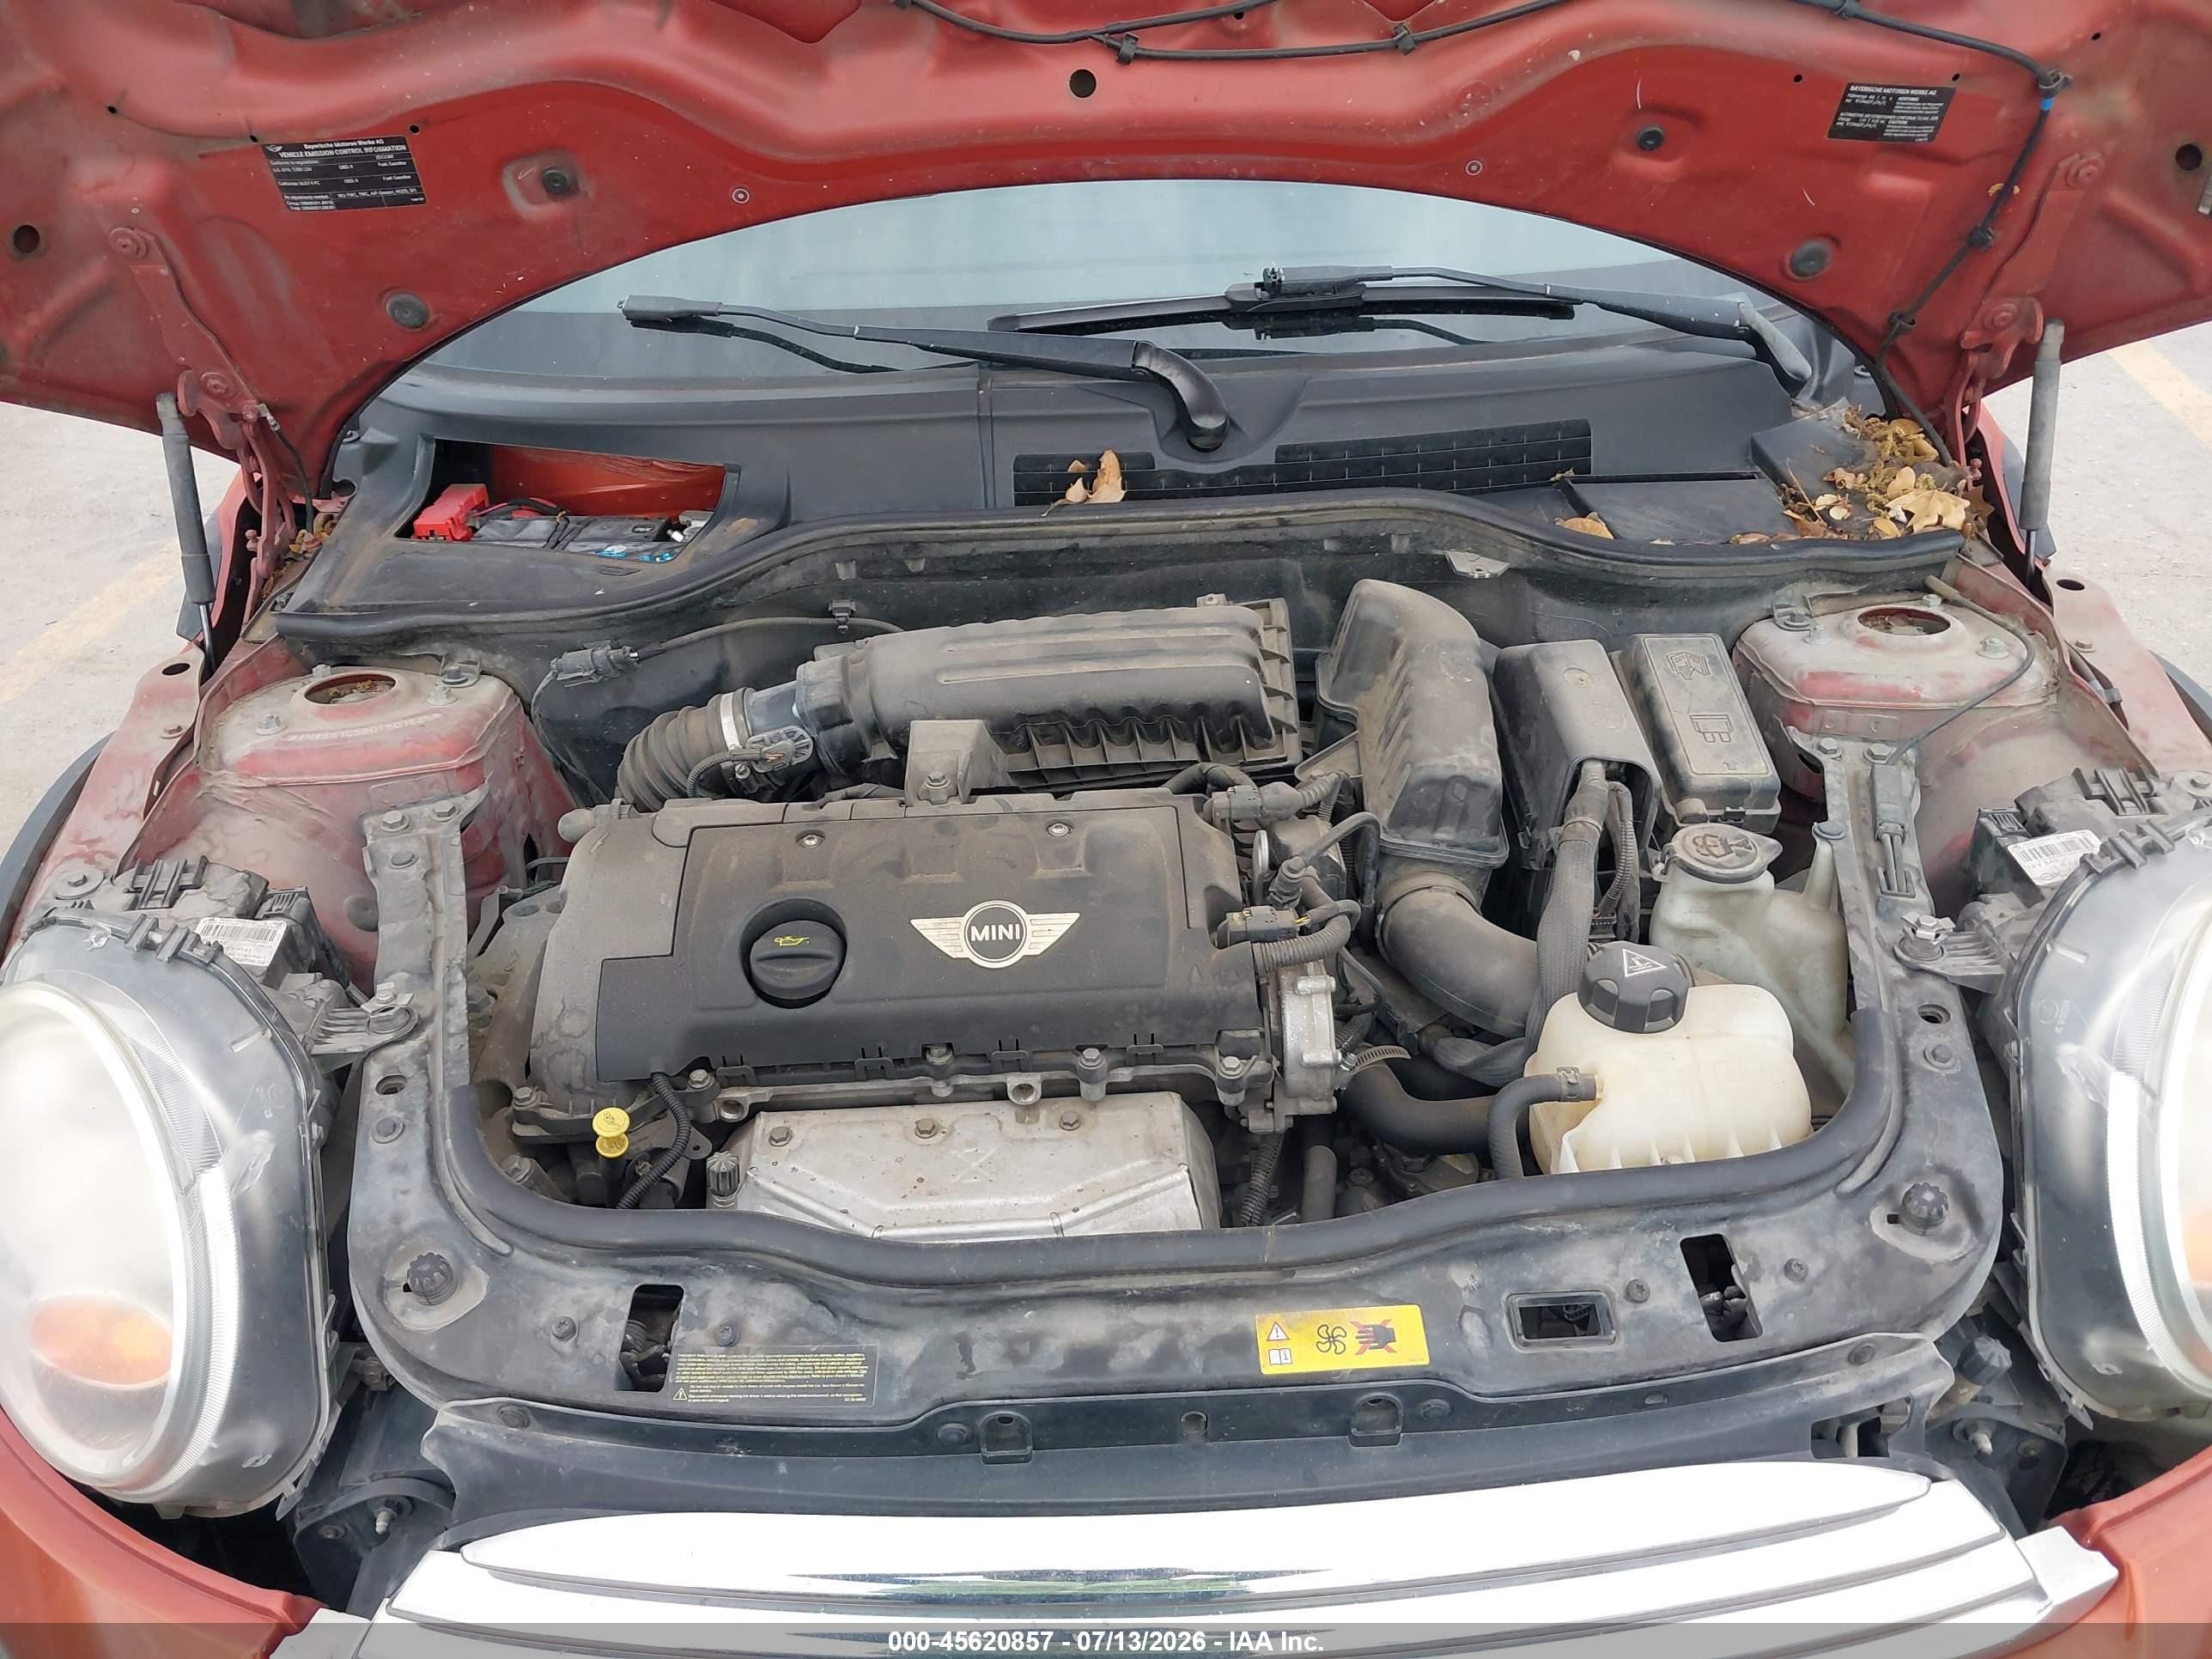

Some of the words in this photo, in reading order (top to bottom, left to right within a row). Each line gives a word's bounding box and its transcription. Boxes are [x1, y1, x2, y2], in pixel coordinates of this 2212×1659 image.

[279, 150, 304, 159] VEHICLE
[305, 149, 335, 157] EMISSION
[335, 147, 364, 155] CONTROL
[364, 144, 407, 154] INFORMATION
[970, 923, 1021, 941] MINI
